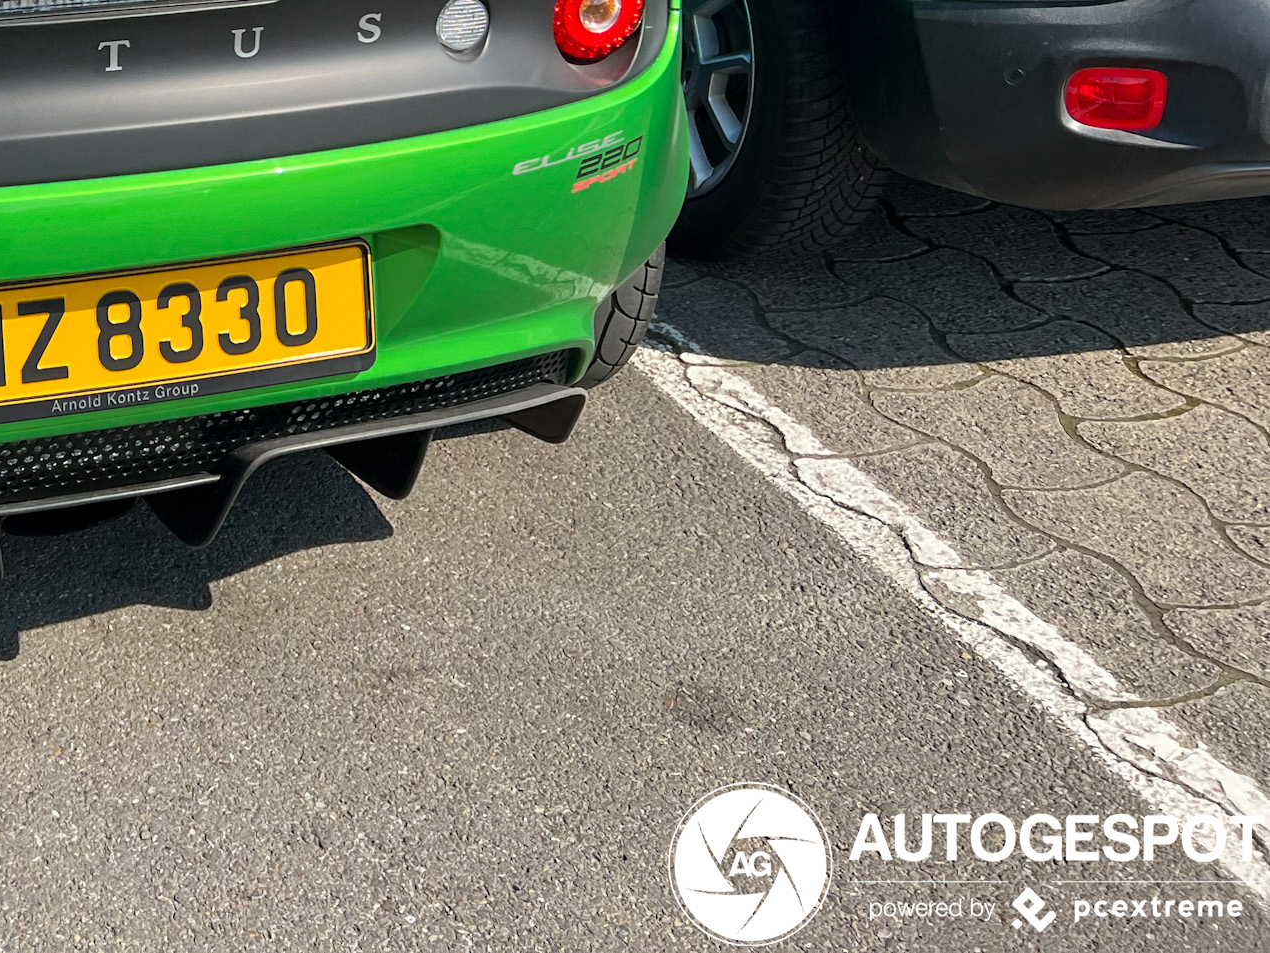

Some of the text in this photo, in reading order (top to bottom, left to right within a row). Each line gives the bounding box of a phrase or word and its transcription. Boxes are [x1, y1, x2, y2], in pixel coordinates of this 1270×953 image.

[571, 157, 638, 193] SPORT
[576, 135, 643, 179] 220
[96, 267, 317, 373] 8330
[51, 383, 199, 413] Arnold Kontz Group
